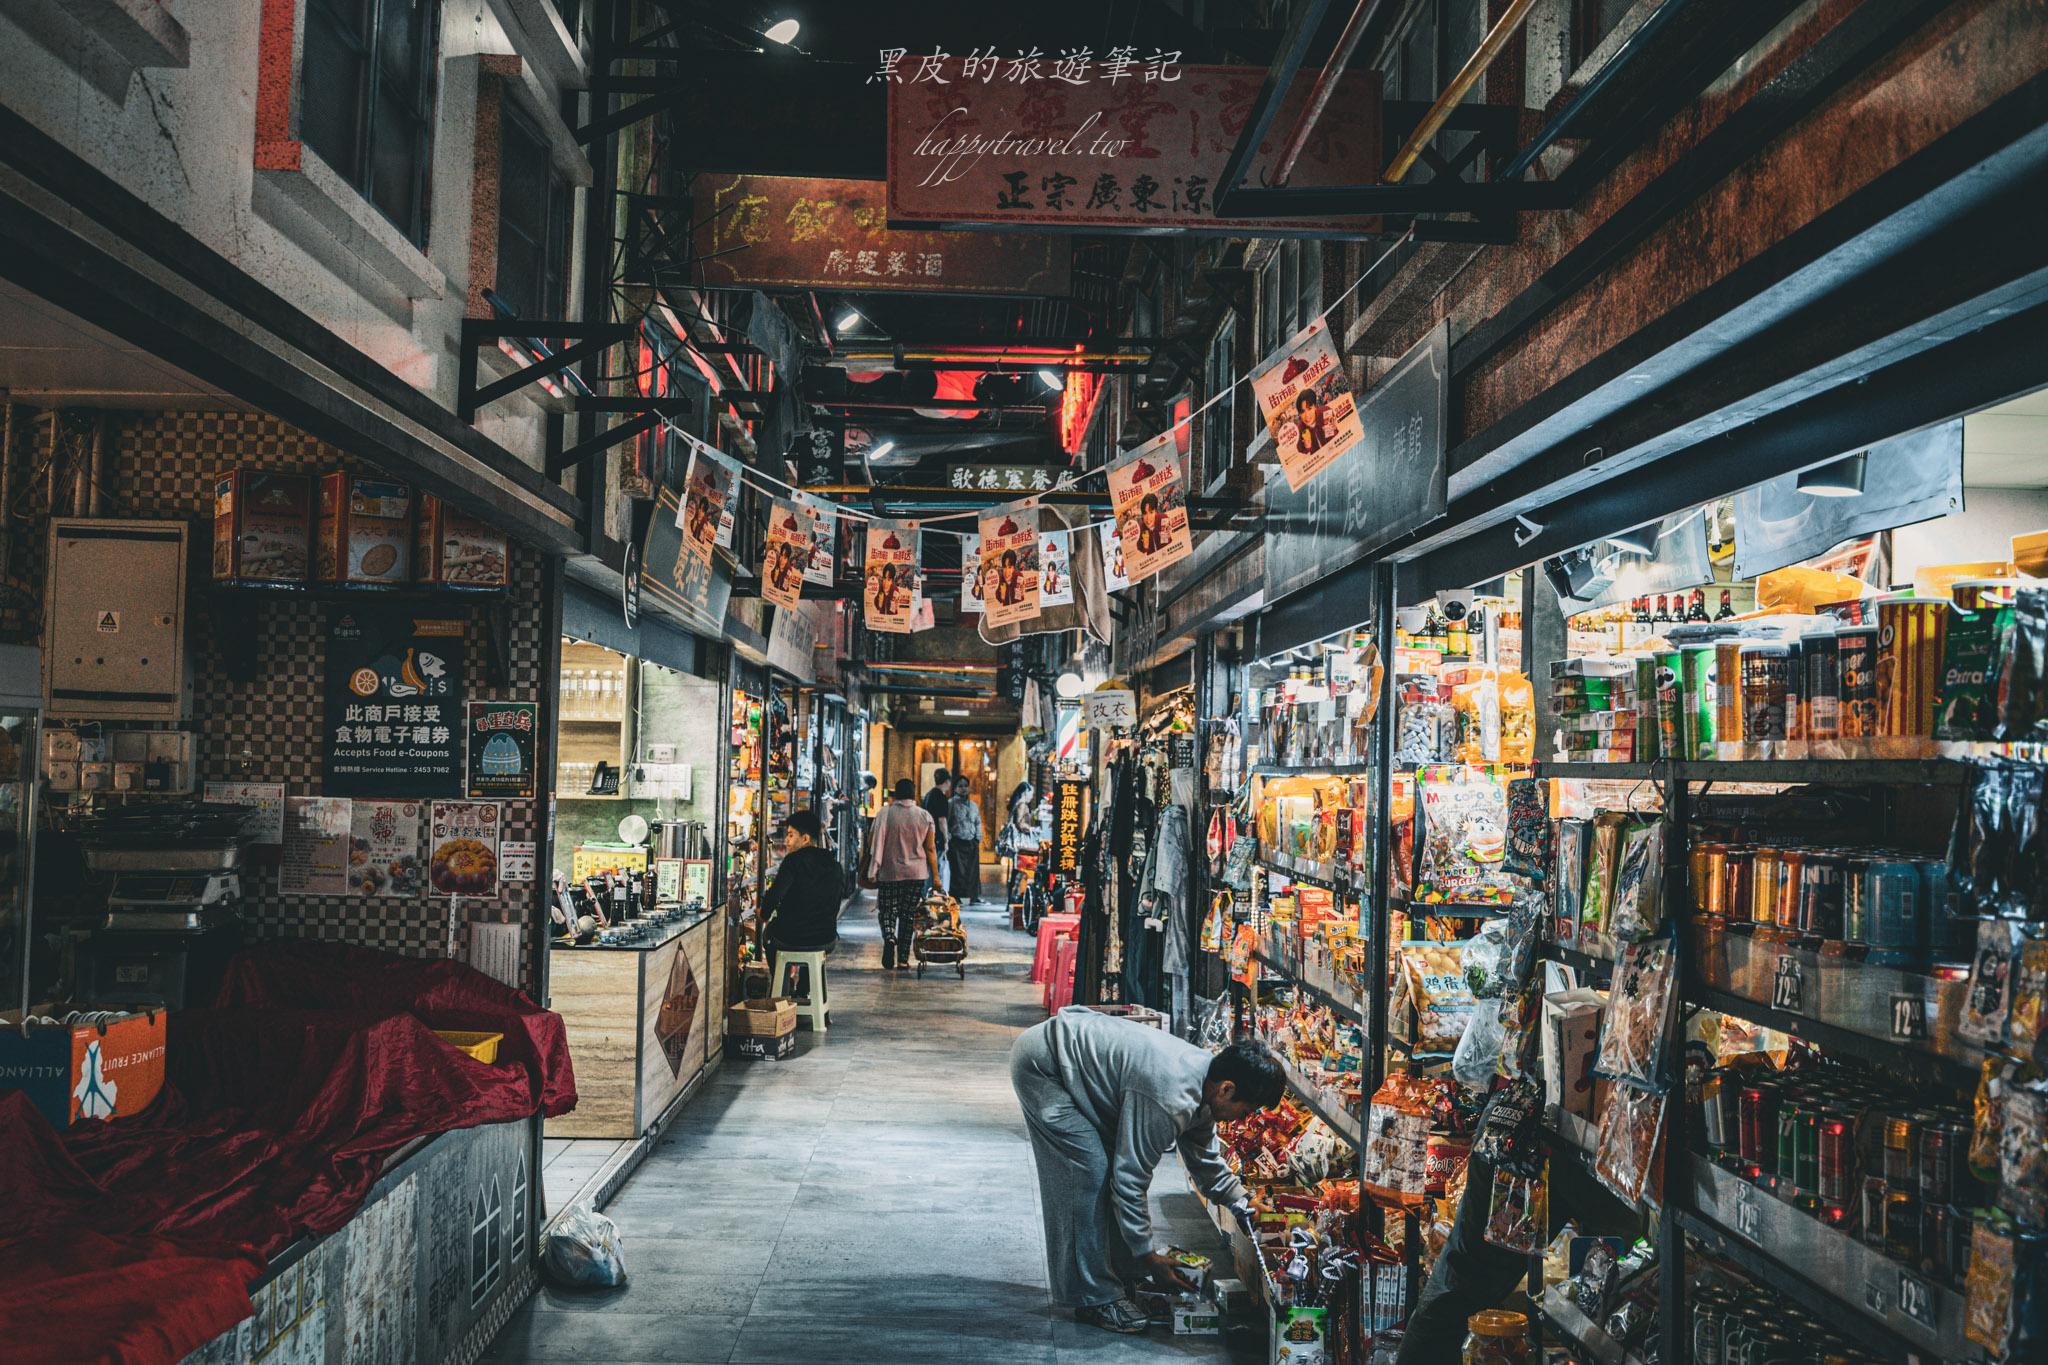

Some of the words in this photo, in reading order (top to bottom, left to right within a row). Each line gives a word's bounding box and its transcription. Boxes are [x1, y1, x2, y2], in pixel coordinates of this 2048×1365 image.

[996, 170, 1250, 215] 正宗廣東涼
[1945, 667, 1984, 686] extra
[345, 704, 441, 723] 此商戶接受
[1093, 701, 1128, 718] 改衣
[335, 725, 450, 744] 食物電子禮券
[334, 748, 371, 758] Accepts
[373, 748, 396, 757] Food
[398, 748, 450, 759] e-Coupons
[413, 766, 431, 774] 2453
[740, 1038, 765, 1054] vita
[102, 1054, 129, 1072] FRUIT
